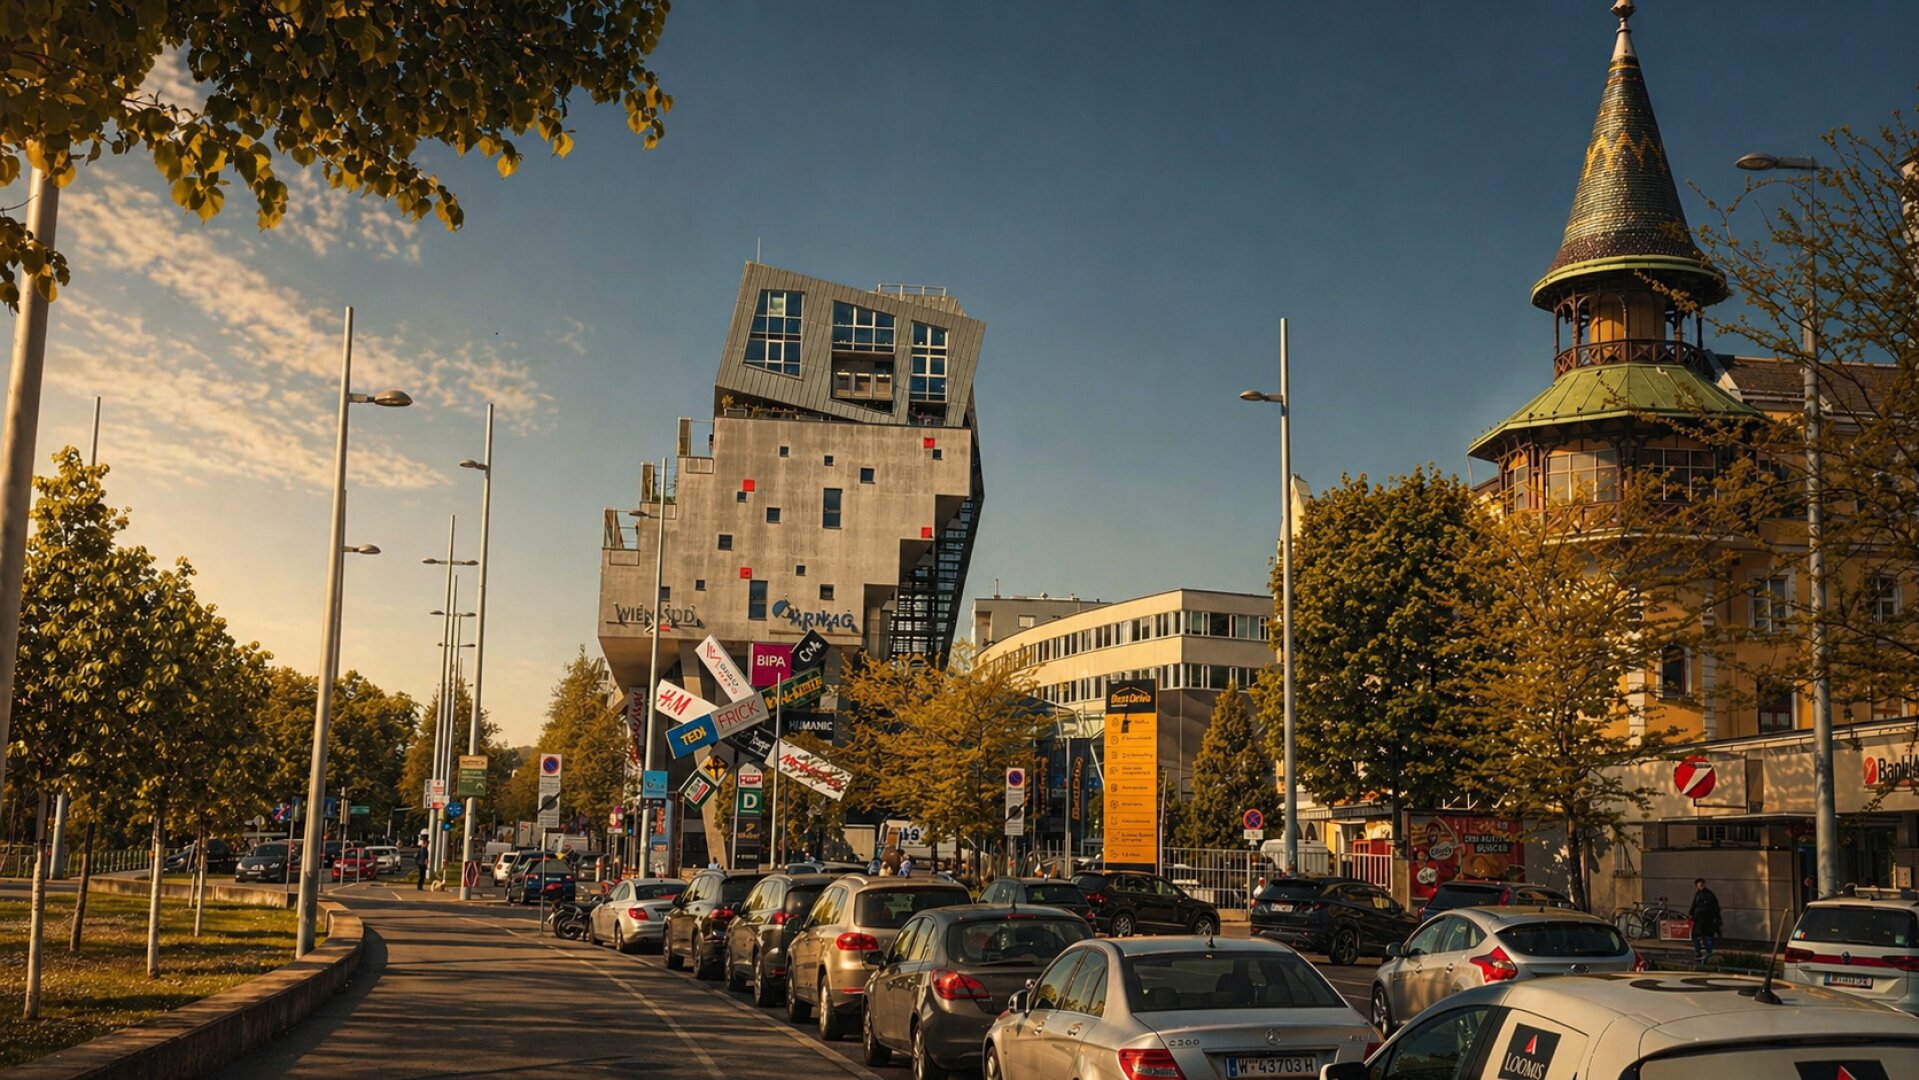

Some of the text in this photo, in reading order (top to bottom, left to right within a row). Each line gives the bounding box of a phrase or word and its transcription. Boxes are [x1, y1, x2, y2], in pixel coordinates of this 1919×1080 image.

[757, 655, 786, 667] BIPA
[717, 700, 760, 729] FRICK
[1505, 1052, 1546, 1080] LOOMIS
